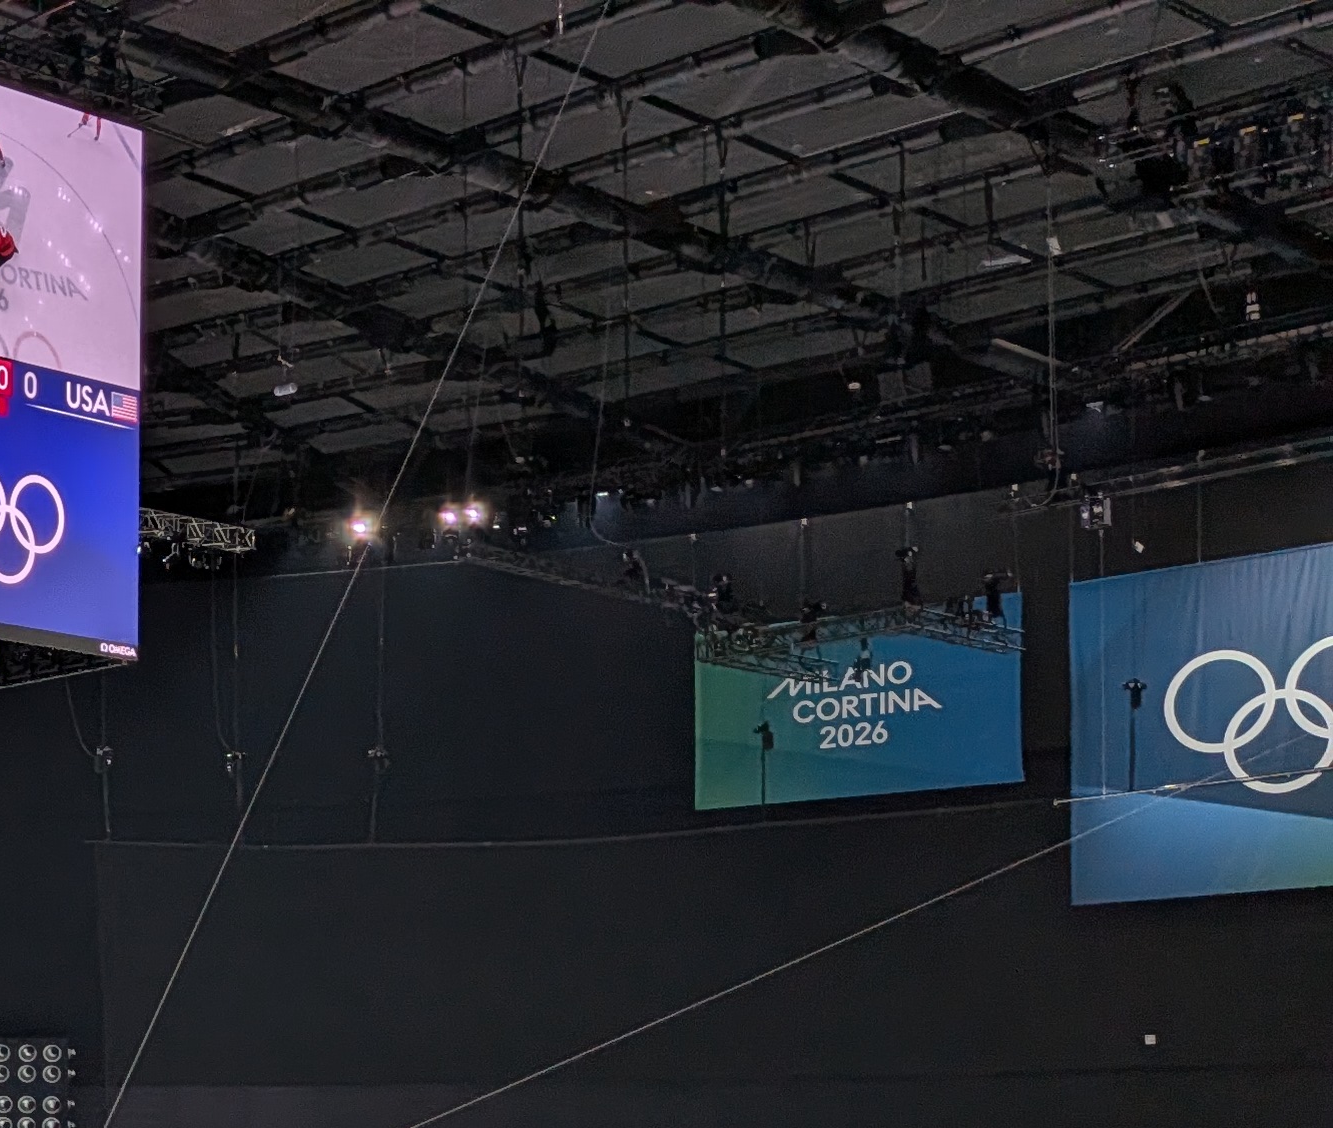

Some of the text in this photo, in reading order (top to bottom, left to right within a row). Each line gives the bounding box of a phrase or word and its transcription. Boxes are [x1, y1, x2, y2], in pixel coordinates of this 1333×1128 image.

[23, 371, 38, 399] 0
[65, 381, 110, 417] USA
[108, 643, 137, 658] OMEGA
[767, 660, 913, 700] MILANO
[792, 687, 943, 725] CORTINA
[818, 720, 889, 750] 2026
